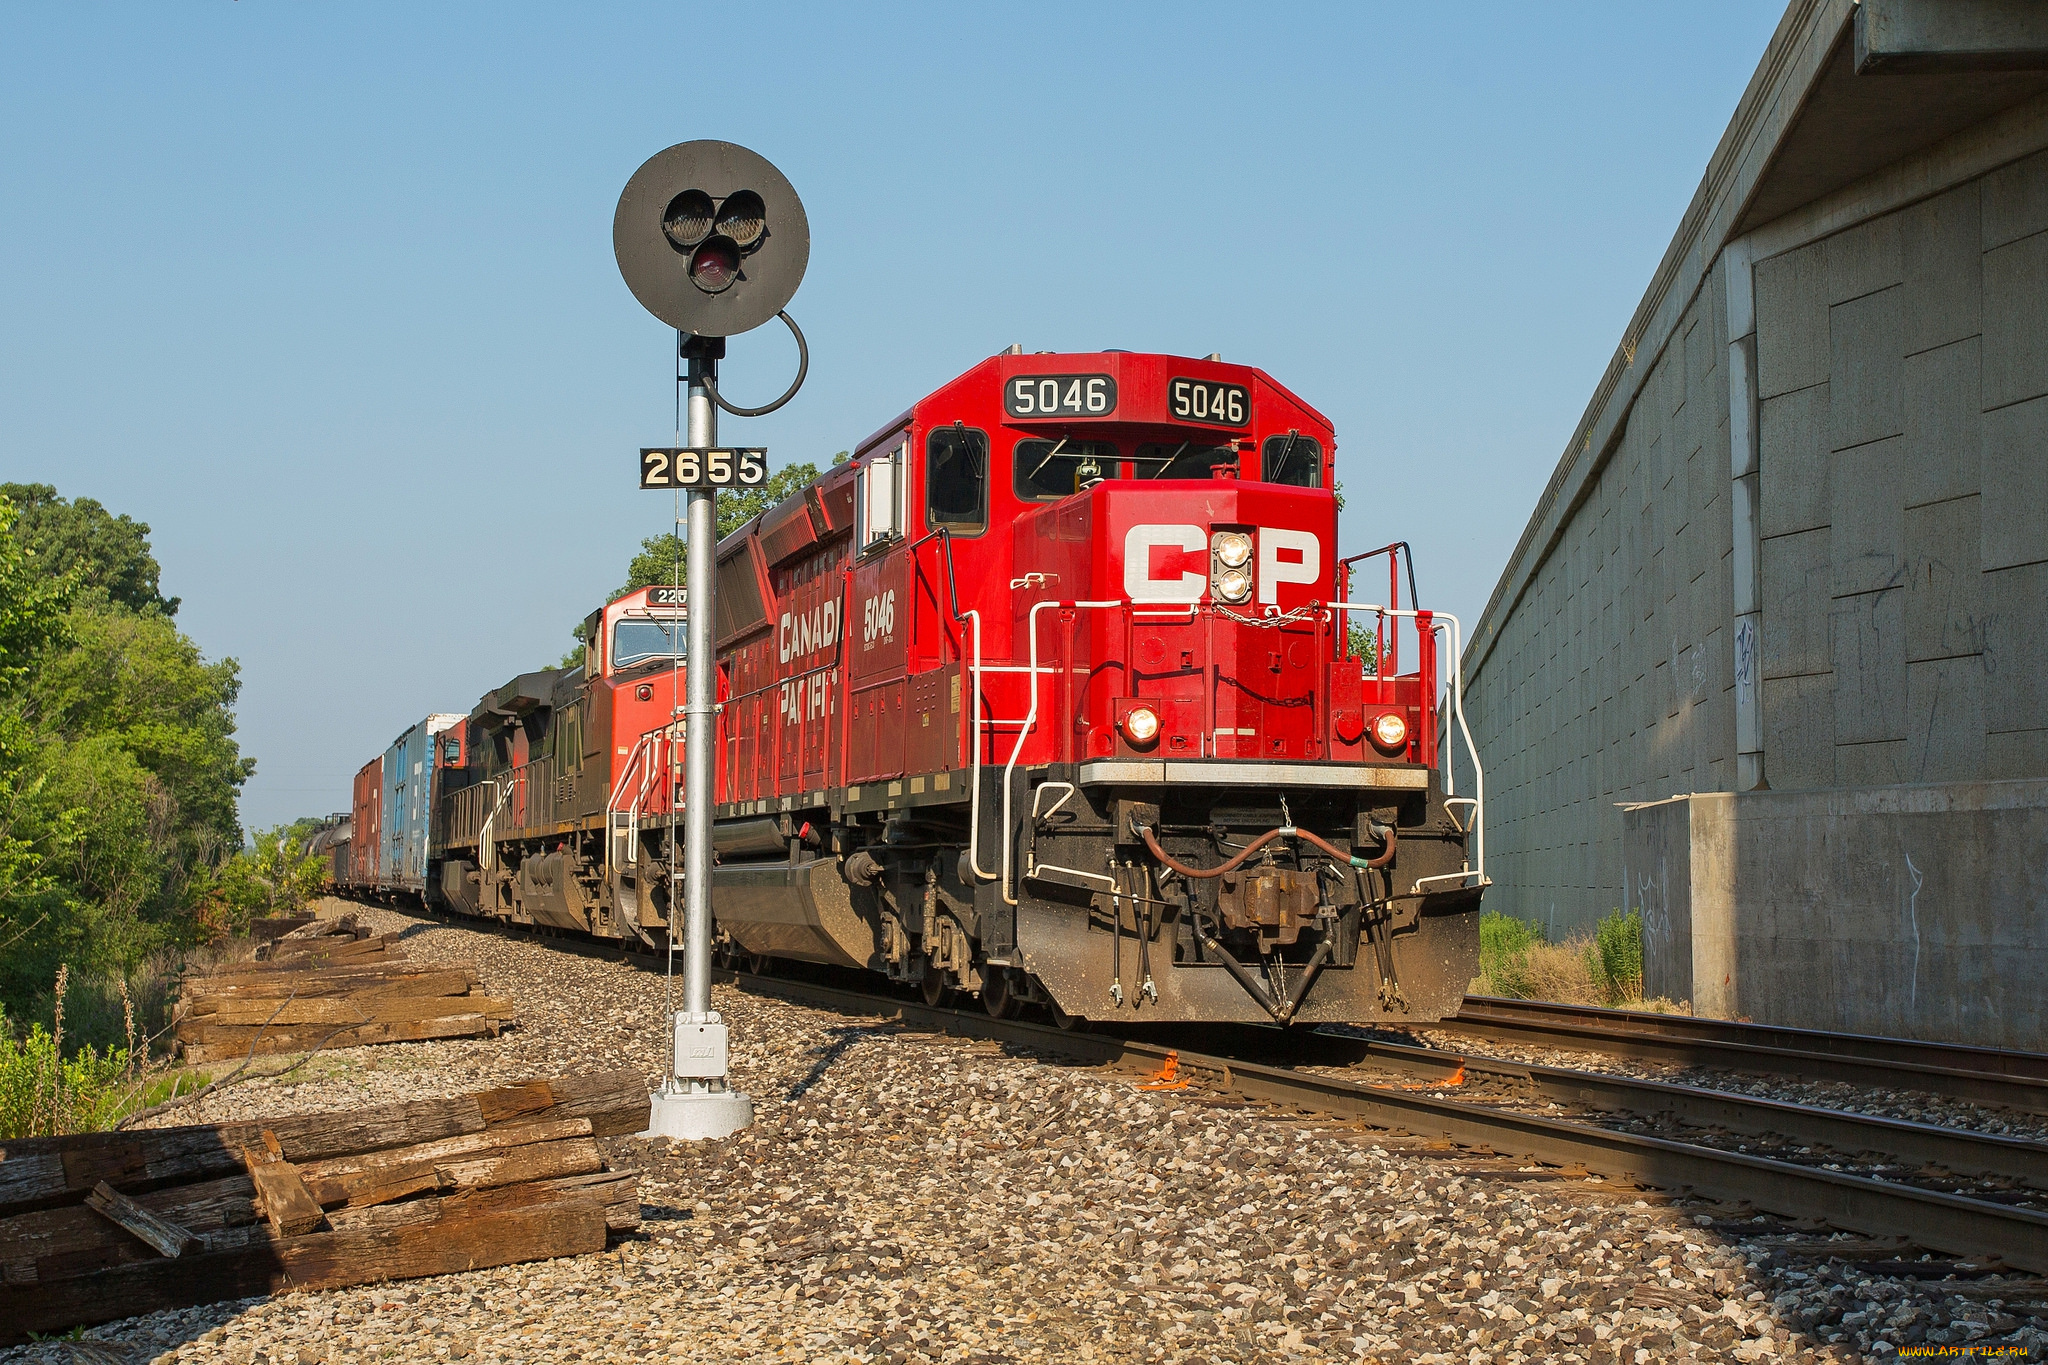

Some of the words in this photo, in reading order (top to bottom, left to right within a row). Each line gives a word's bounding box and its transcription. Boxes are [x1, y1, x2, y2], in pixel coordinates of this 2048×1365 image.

[1015, 379, 1106, 413] 5046
[1175, 382, 1243, 422] 5046
[645, 452, 763, 484] 2655
[658, 589, 687, 603] 220
[780, 596, 852, 664] CANADI
[864, 589, 894, 642] 5046
